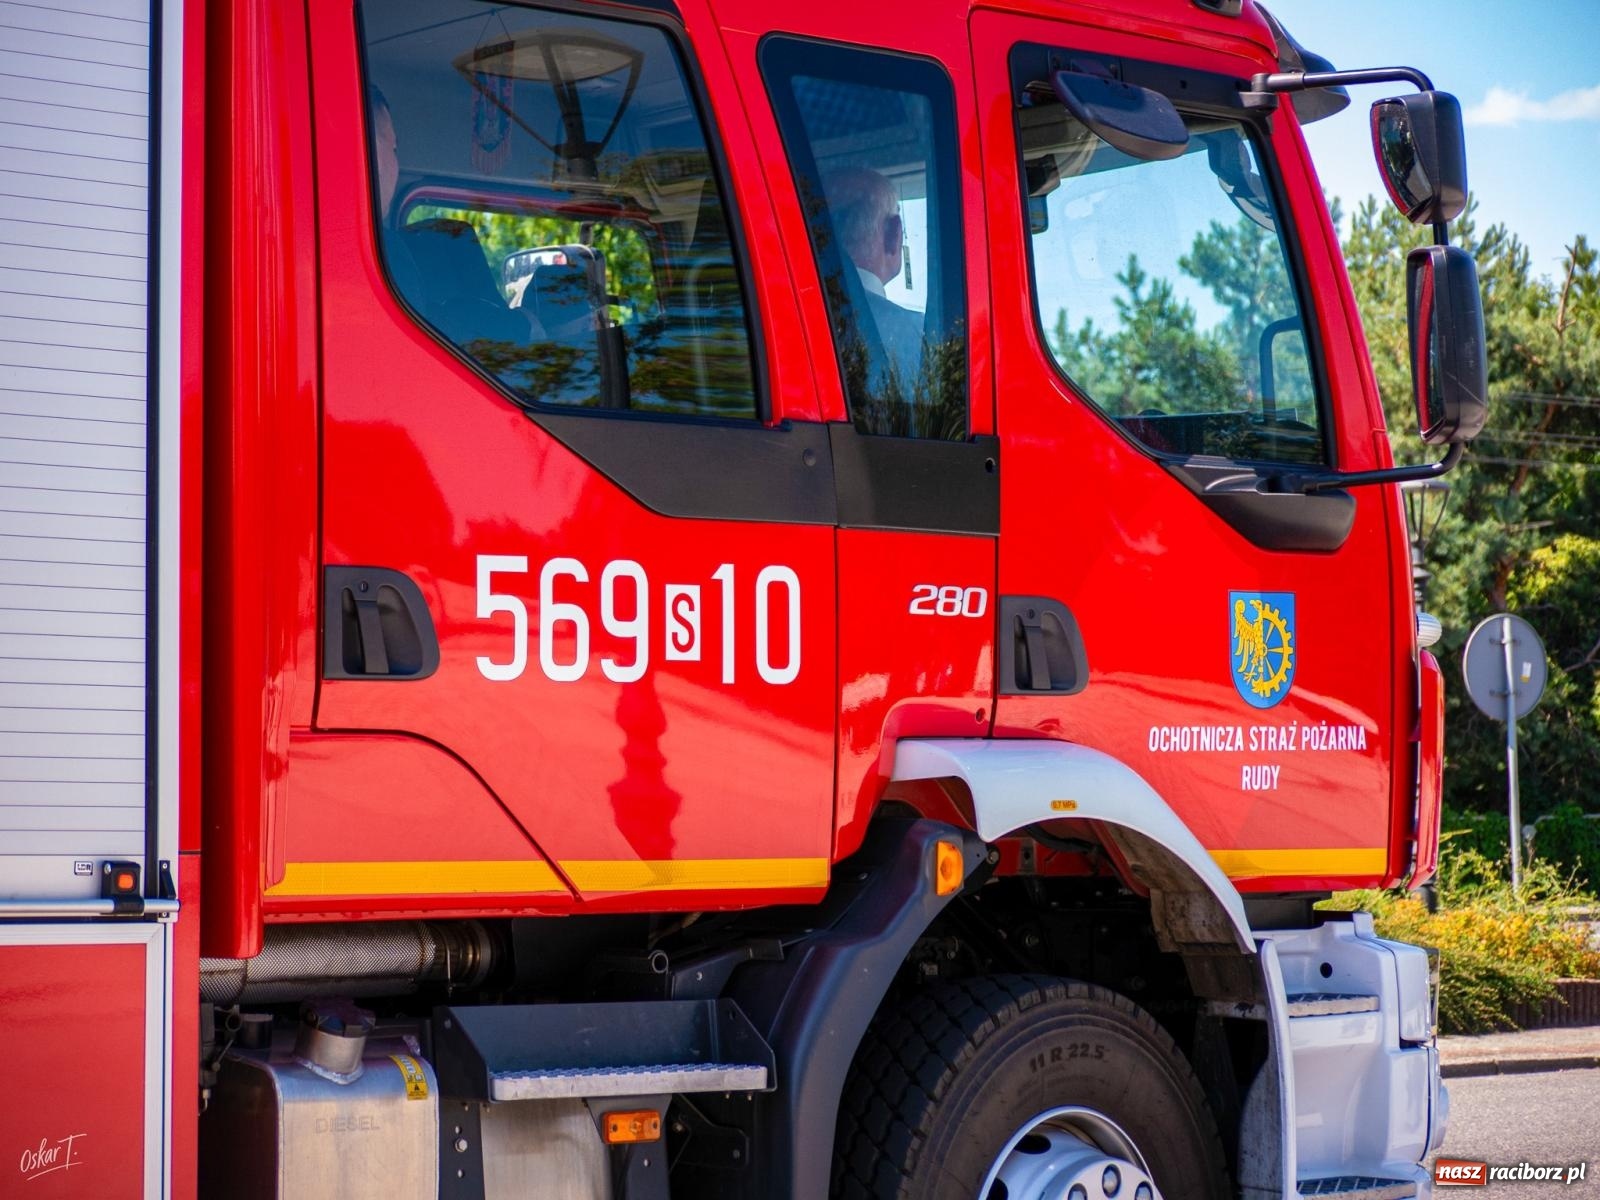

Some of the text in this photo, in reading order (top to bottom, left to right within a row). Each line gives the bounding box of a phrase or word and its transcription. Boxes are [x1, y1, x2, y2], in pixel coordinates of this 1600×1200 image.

[908, 584, 988, 619] 280
[475, 553, 801, 685] 569 S 10
[1148, 719, 1367, 752] OCHOTNICZA STRAŻ POŻARNA
[1241, 765, 1280, 791] RUDY
[1029, 1052, 1045, 1073] 11
[1050, 1045, 1063, 1063] R
[315, 1115, 380, 1134] DIESEL
